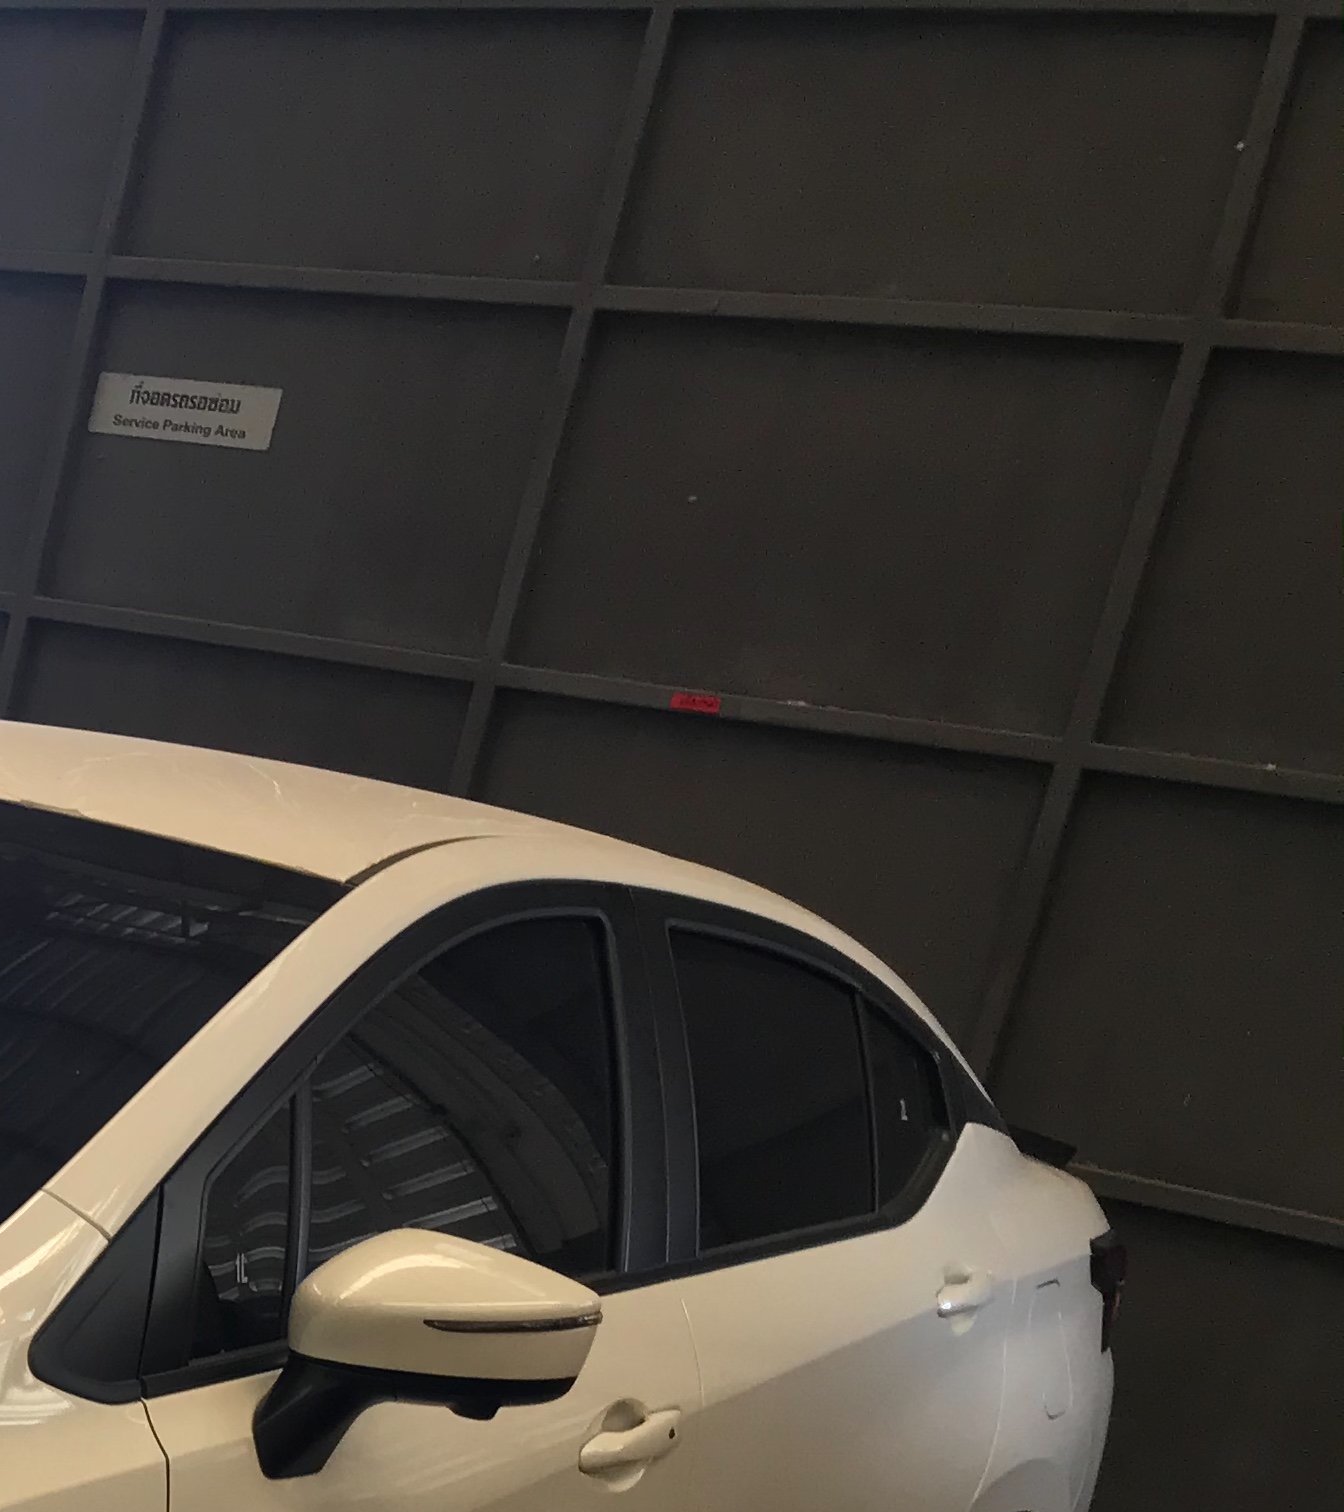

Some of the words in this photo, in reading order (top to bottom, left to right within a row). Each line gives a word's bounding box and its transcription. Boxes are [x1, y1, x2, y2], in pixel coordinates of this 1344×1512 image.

[129, 381, 242, 416] ที่จอดรถรอซ่อม
[112, 413, 160, 431] Service
[162, 418, 211, 438] Parking
[214, 423, 247, 440] Area
